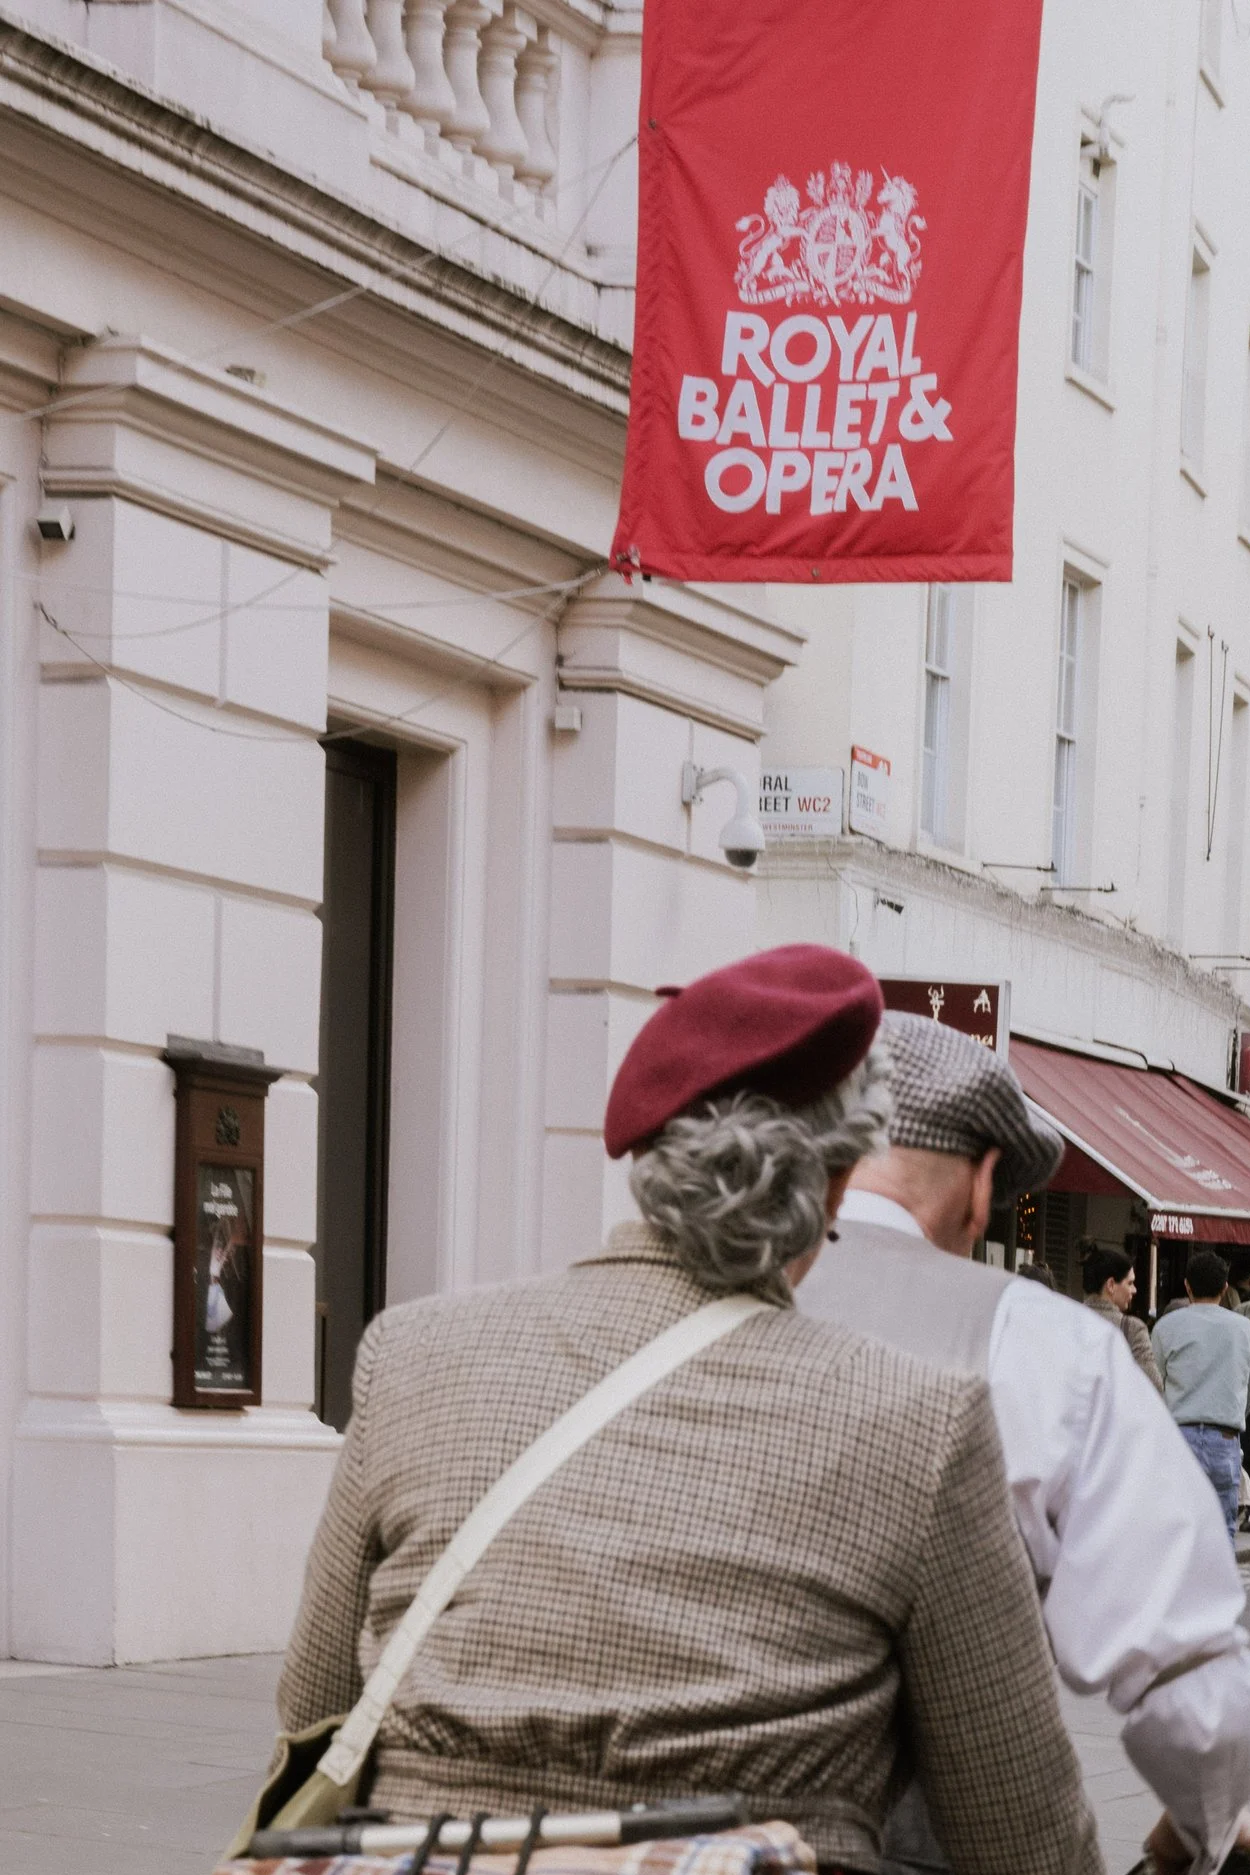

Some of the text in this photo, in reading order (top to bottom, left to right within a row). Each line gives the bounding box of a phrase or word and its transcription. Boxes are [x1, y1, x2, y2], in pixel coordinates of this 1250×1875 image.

[721, 310, 922, 388] ROYAL
[704, 443, 920, 517] OPERA
[760, 775, 792, 792] RAL
[797, 796, 832, 813] WC2
[762, 822, 814, 832] WESTMINSTER
